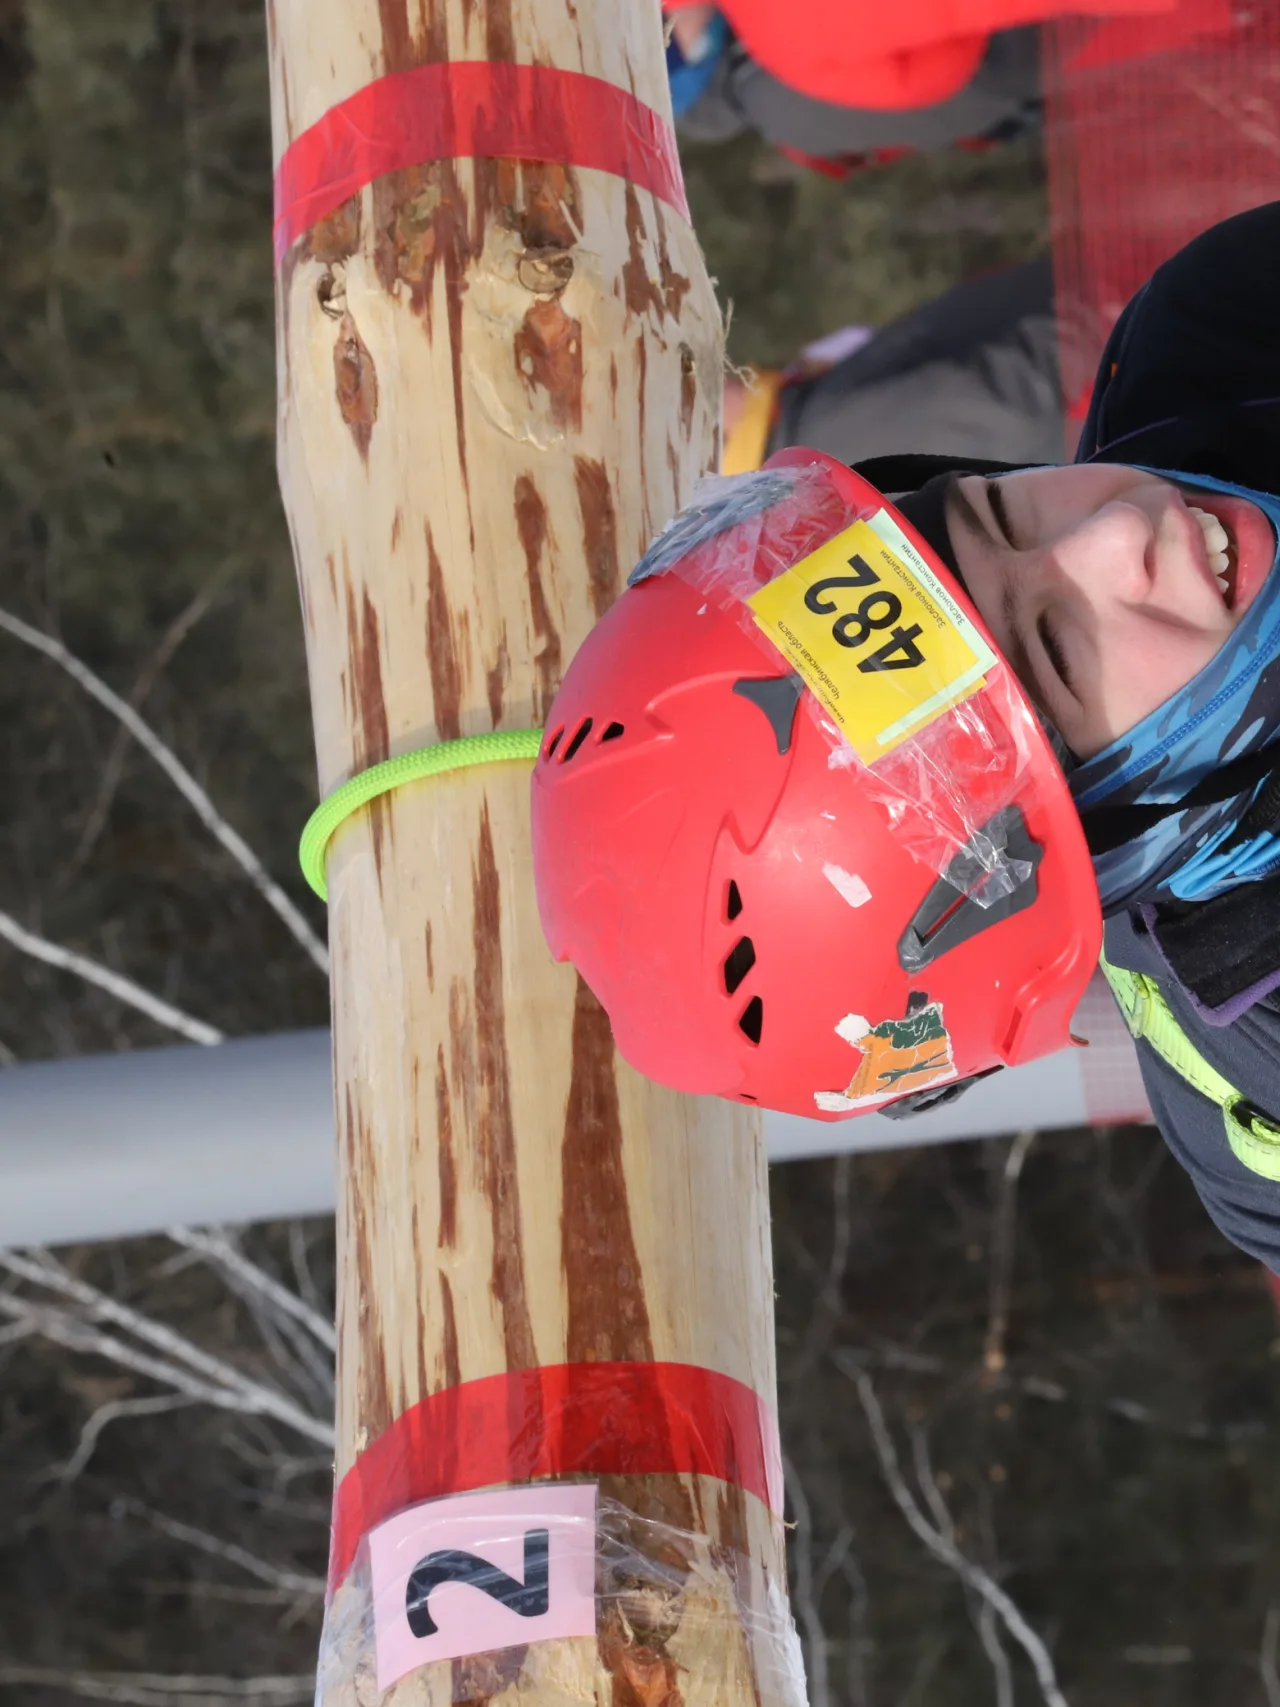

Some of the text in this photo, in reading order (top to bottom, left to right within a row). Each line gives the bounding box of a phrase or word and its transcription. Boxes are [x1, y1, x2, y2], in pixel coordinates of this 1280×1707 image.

[804, 553, 926, 673] 482
[880, 550, 946, 629] Заслонов Константин
[901, 543, 965, 626] Заслонов Константин
[778, 620, 803, 649] область
[801, 648, 840, 700] Челябинская
[405, 1528, 549, 1639] 2
